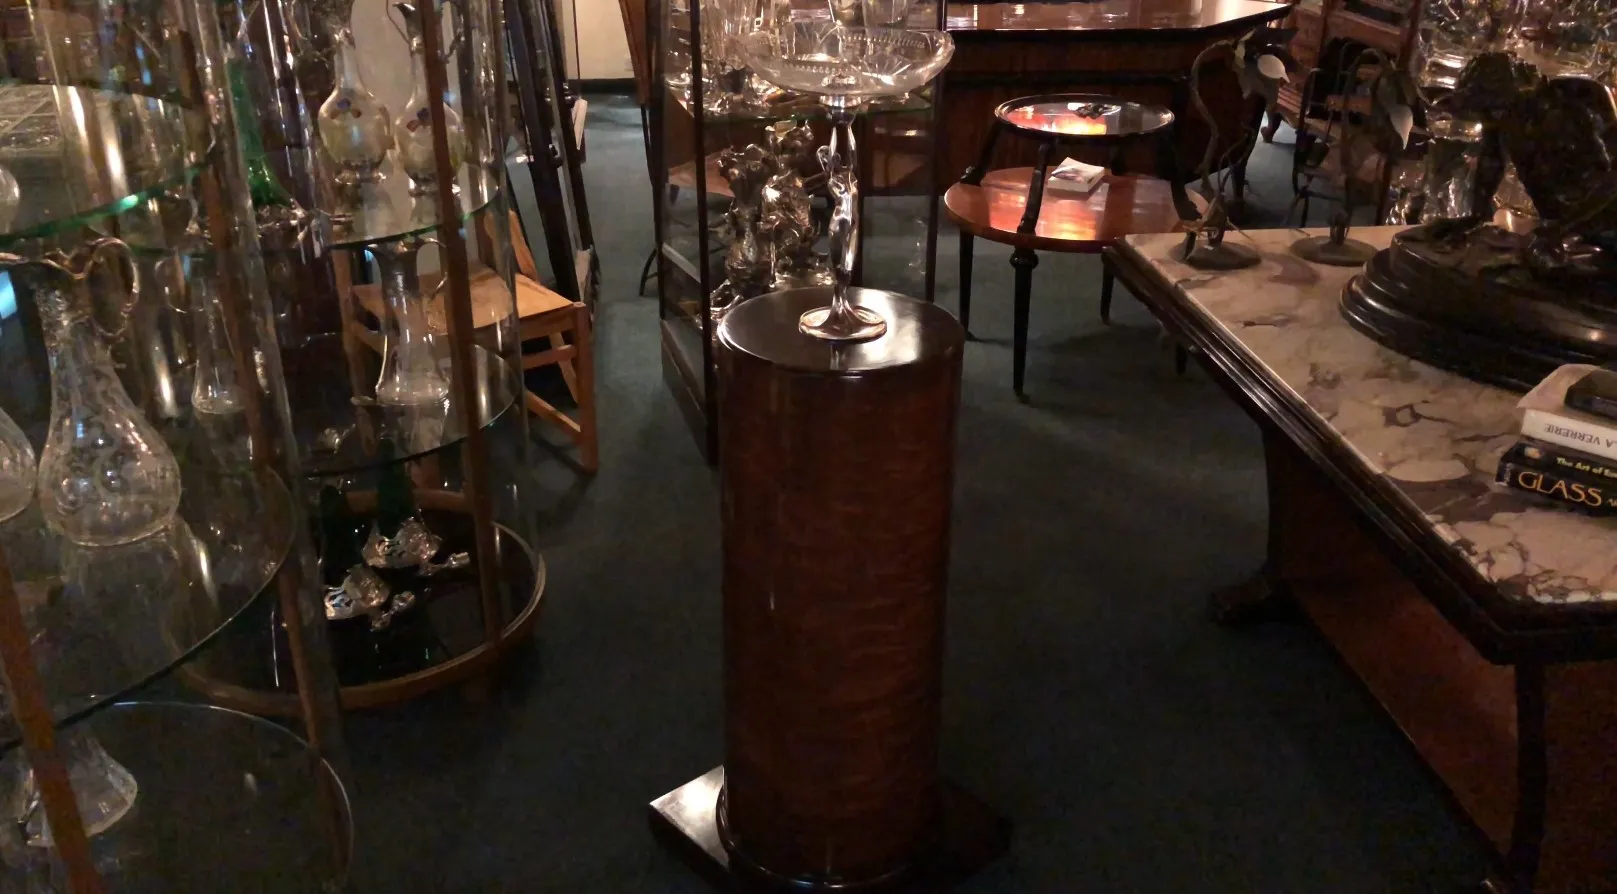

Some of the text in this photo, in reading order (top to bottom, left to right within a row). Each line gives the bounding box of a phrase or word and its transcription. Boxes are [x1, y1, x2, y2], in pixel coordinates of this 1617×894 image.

[1544, 424, 1600, 445] VERRERIE
[1556, 457, 1573, 467] The
[1575, 462, 1590, 471] Art
[1592, 467, 1603, 475] of
[1518, 471, 1602, 507] GLASS
